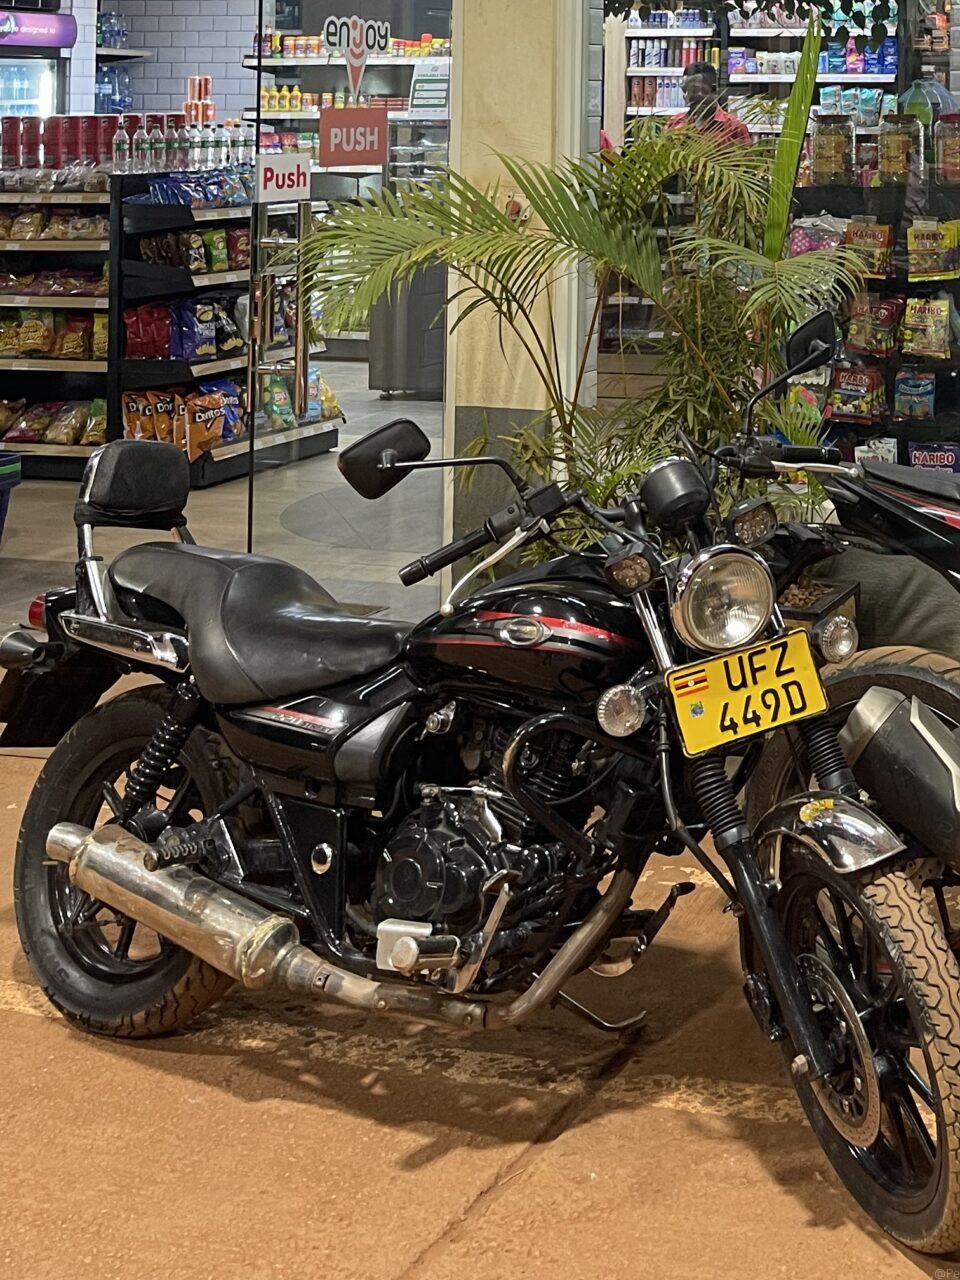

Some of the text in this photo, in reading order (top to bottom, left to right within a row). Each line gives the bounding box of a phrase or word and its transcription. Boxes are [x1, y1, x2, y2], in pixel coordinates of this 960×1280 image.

[326, 19, 388, 52] enjoy
[330, 127, 378, 152] PUSH
[263, 164, 306, 190] Push
[911, 305, 942, 316] HARIBO
[195, 408, 226, 423] Doritos
[912, 451, 955, 466] HARIBO
[722, 640, 796, 692] UFZ
[718, 679, 808, 736] 449D
